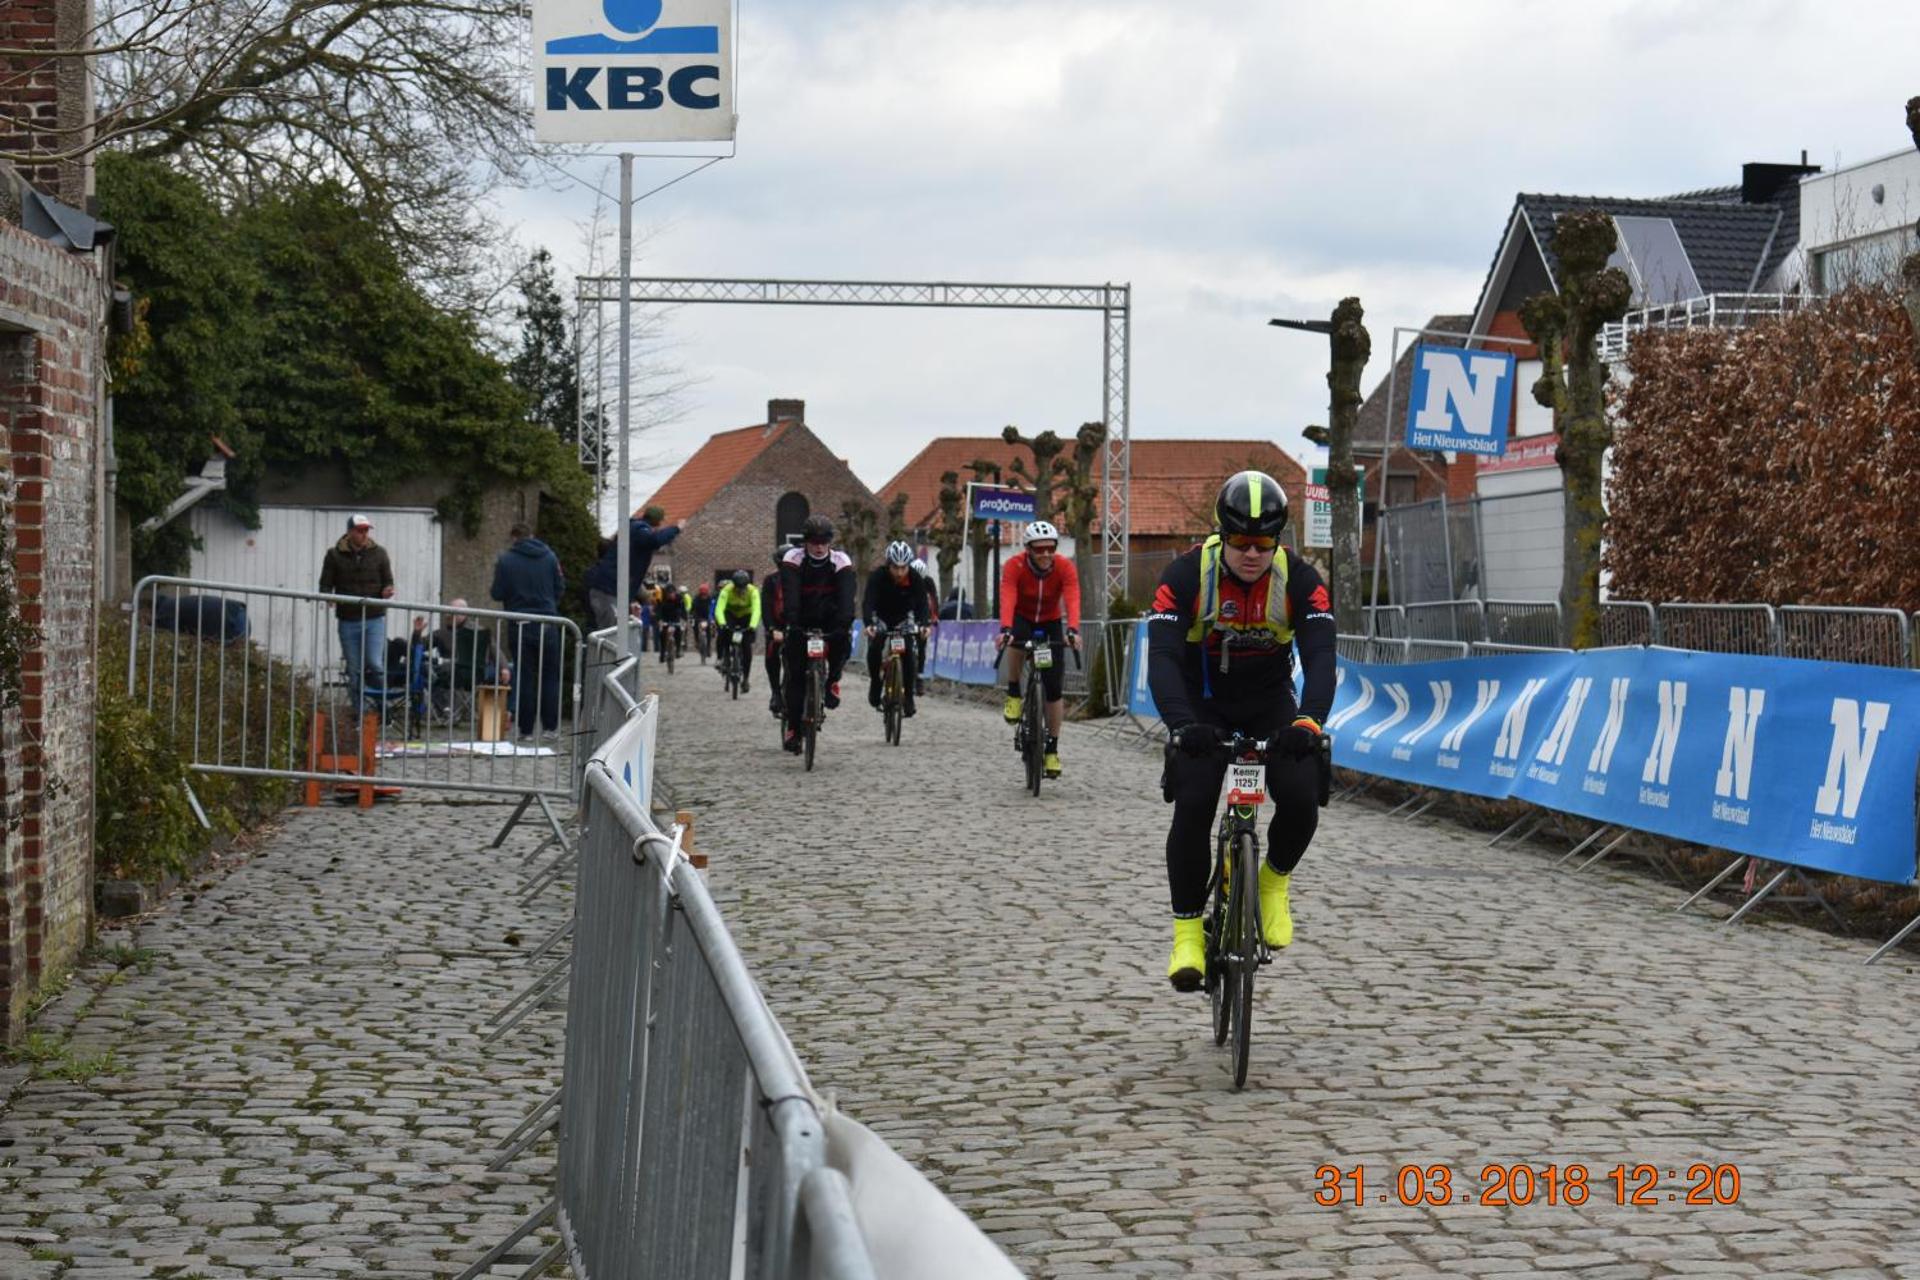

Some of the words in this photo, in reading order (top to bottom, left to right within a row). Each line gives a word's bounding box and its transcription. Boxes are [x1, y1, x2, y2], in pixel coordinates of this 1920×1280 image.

[546, 65, 720, 111] KBC
[1415, 351, 1507, 435] N
[1413, 431, 1431, 447] Het
[1433, 433, 1498, 452] Nieuwsblad
[1642, 680, 1687, 785] N
[1715, 686, 1765, 800] N
[1814, 697, 1891, 819] N
[1233, 767, 1260, 777] Kenny
[1234, 778, 1258, 787] 11257
